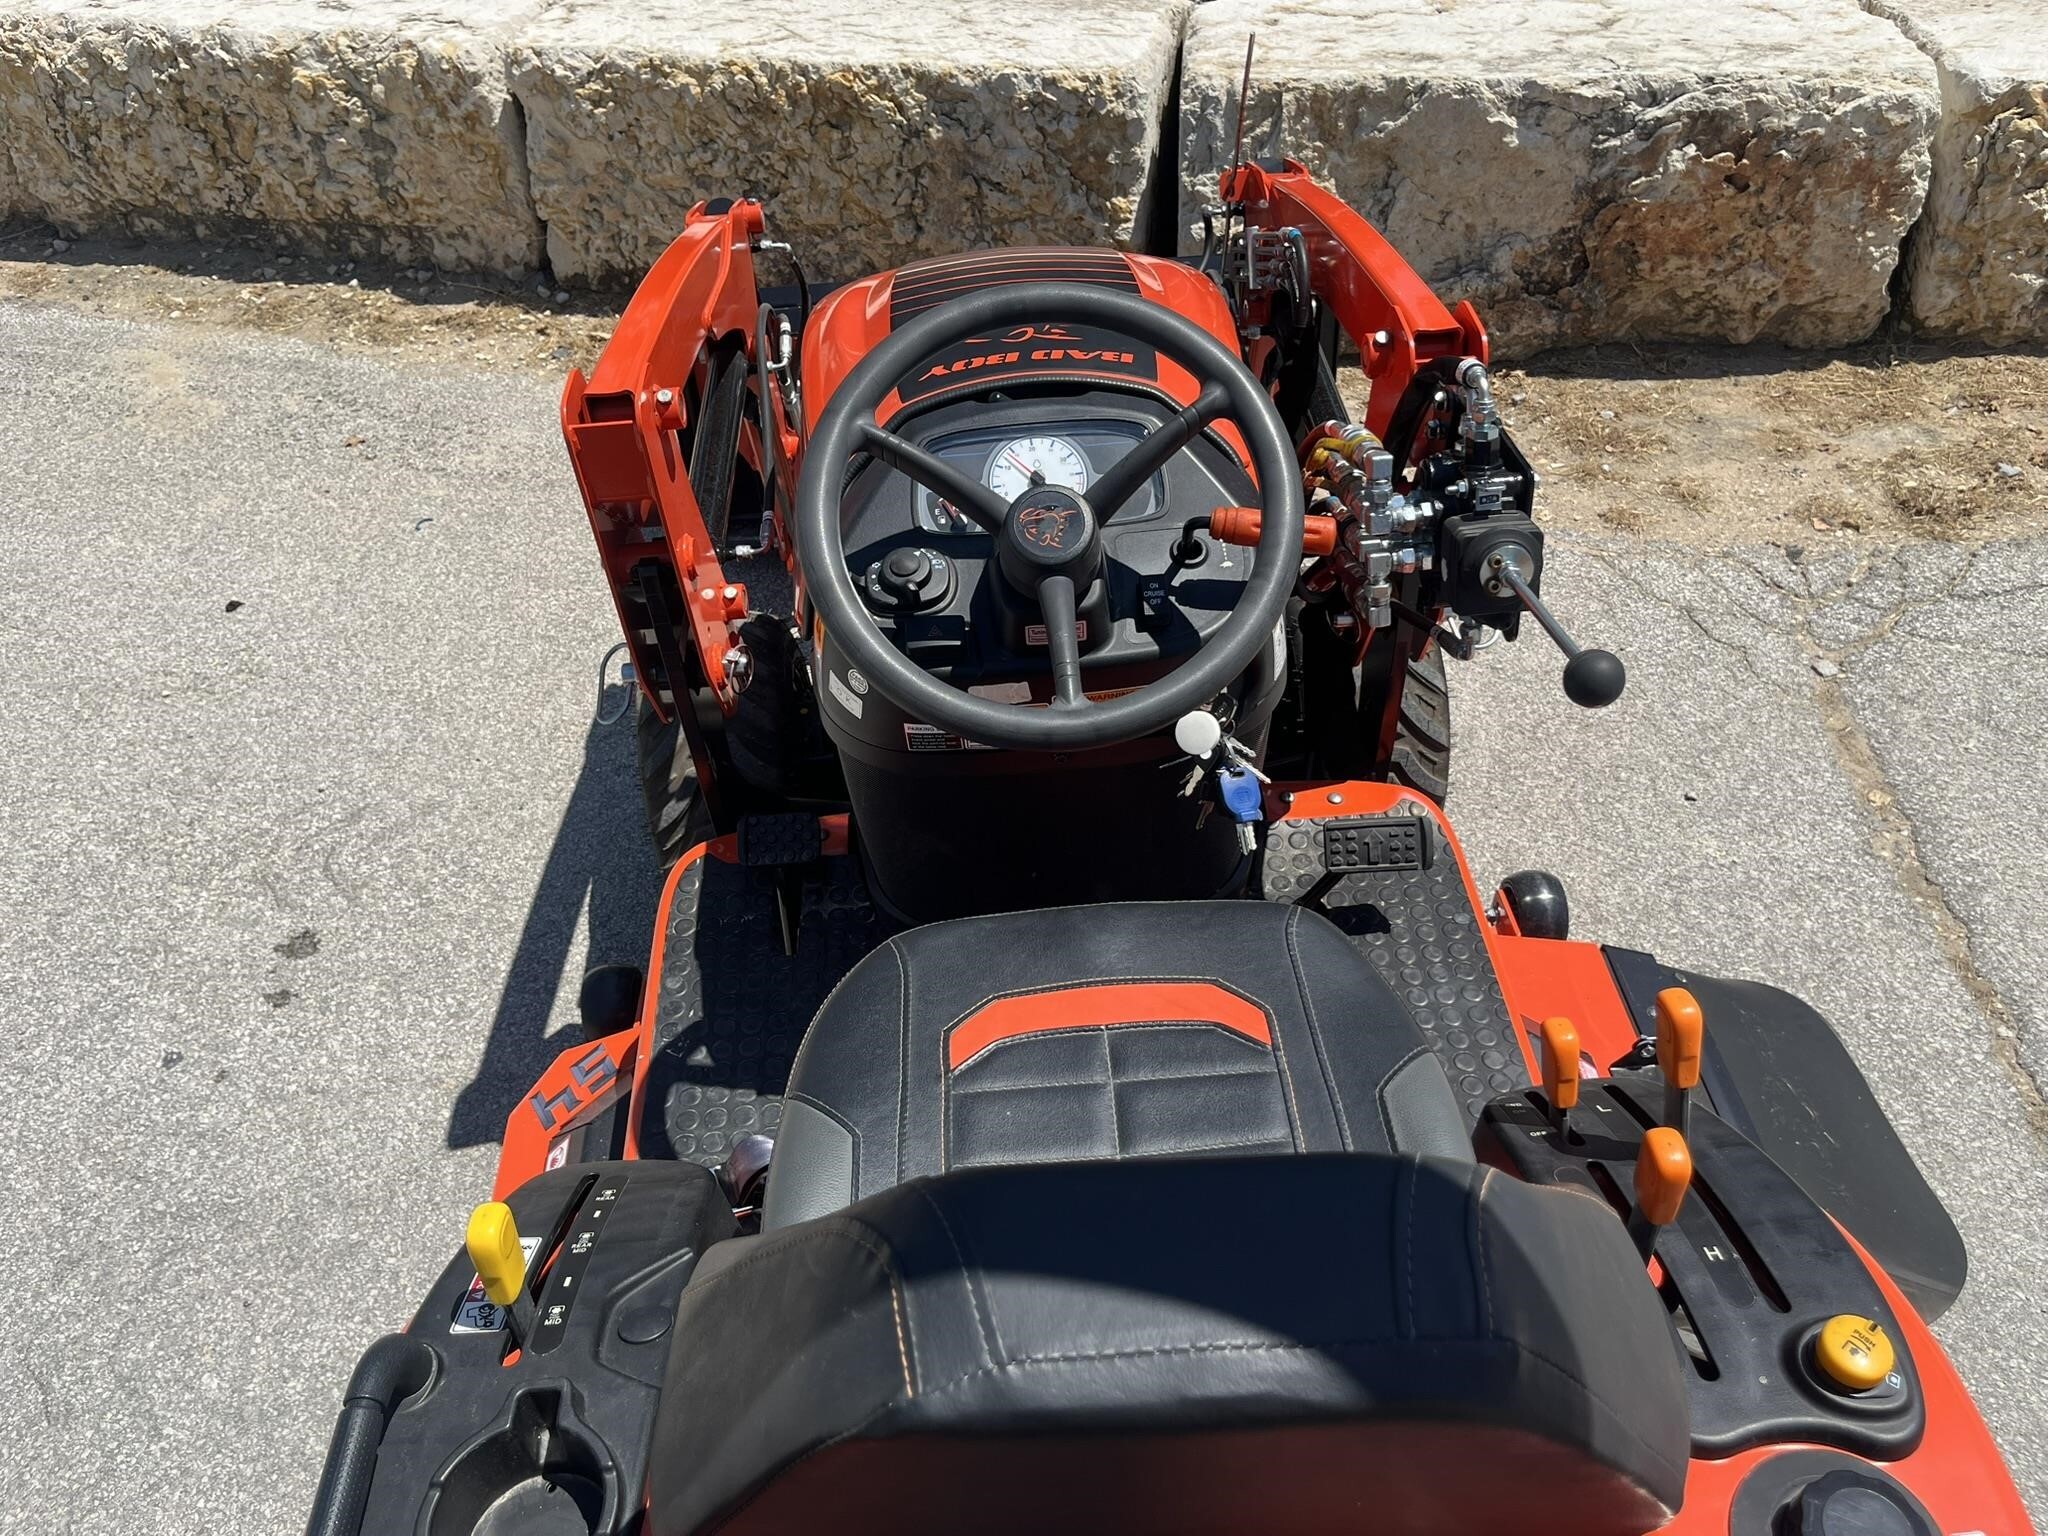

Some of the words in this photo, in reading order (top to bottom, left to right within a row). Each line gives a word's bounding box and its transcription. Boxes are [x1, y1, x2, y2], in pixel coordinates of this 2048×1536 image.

[1031, 349, 1134, 363] BAD
[918, 351, 1020, 382] BOY
[934, 508, 941, 516] E
[1595, 1104, 1613, 1112] L
[1703, 1245, 1724, 1261] H
[543, 1318, 562, 1326] MID
[1852, 1328, 1877, 1348] PUSH
